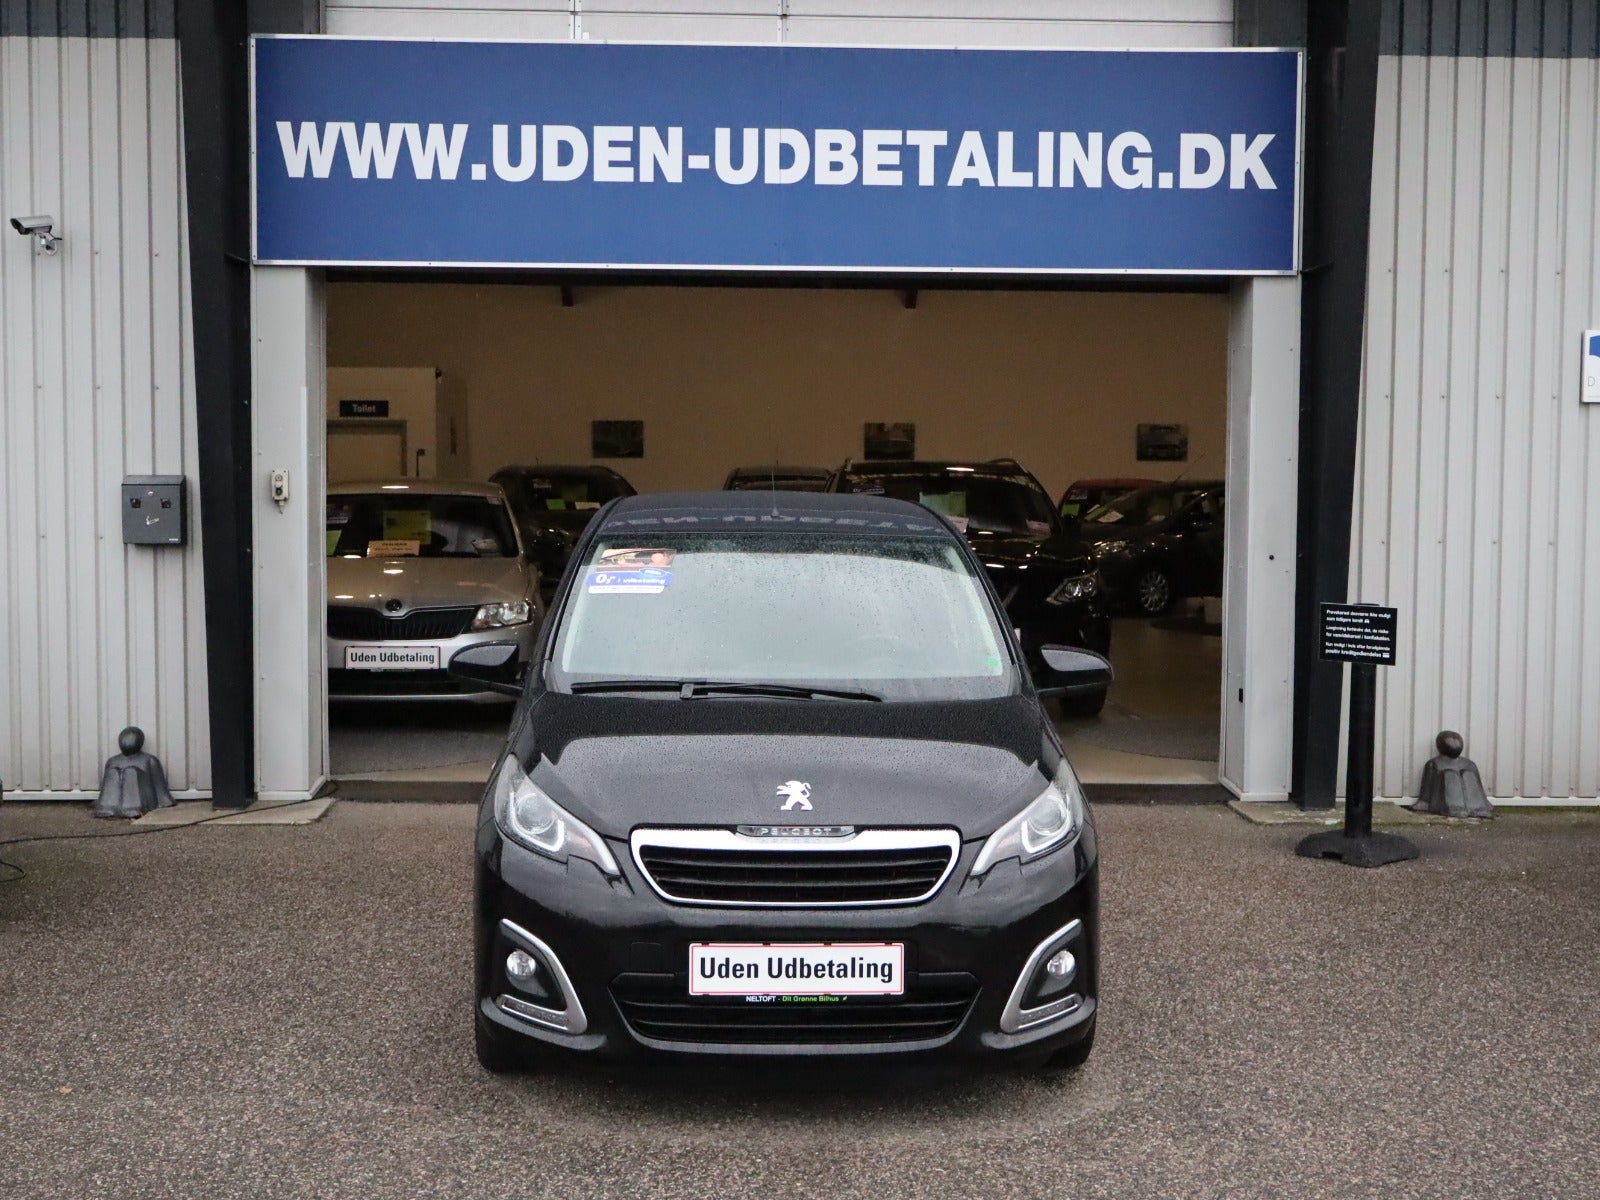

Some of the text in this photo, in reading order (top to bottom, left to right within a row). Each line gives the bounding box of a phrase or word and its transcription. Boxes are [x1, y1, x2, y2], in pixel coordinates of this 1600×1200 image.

[275, 120, 1277, 191] WWW.UDEN-UDBETALING.DK
[352, 403, 376, 413] Toilet
[350, 652, 435, 664] Uden Udbetaling
[700, 957, 893, 984] Uden Udbetaling
